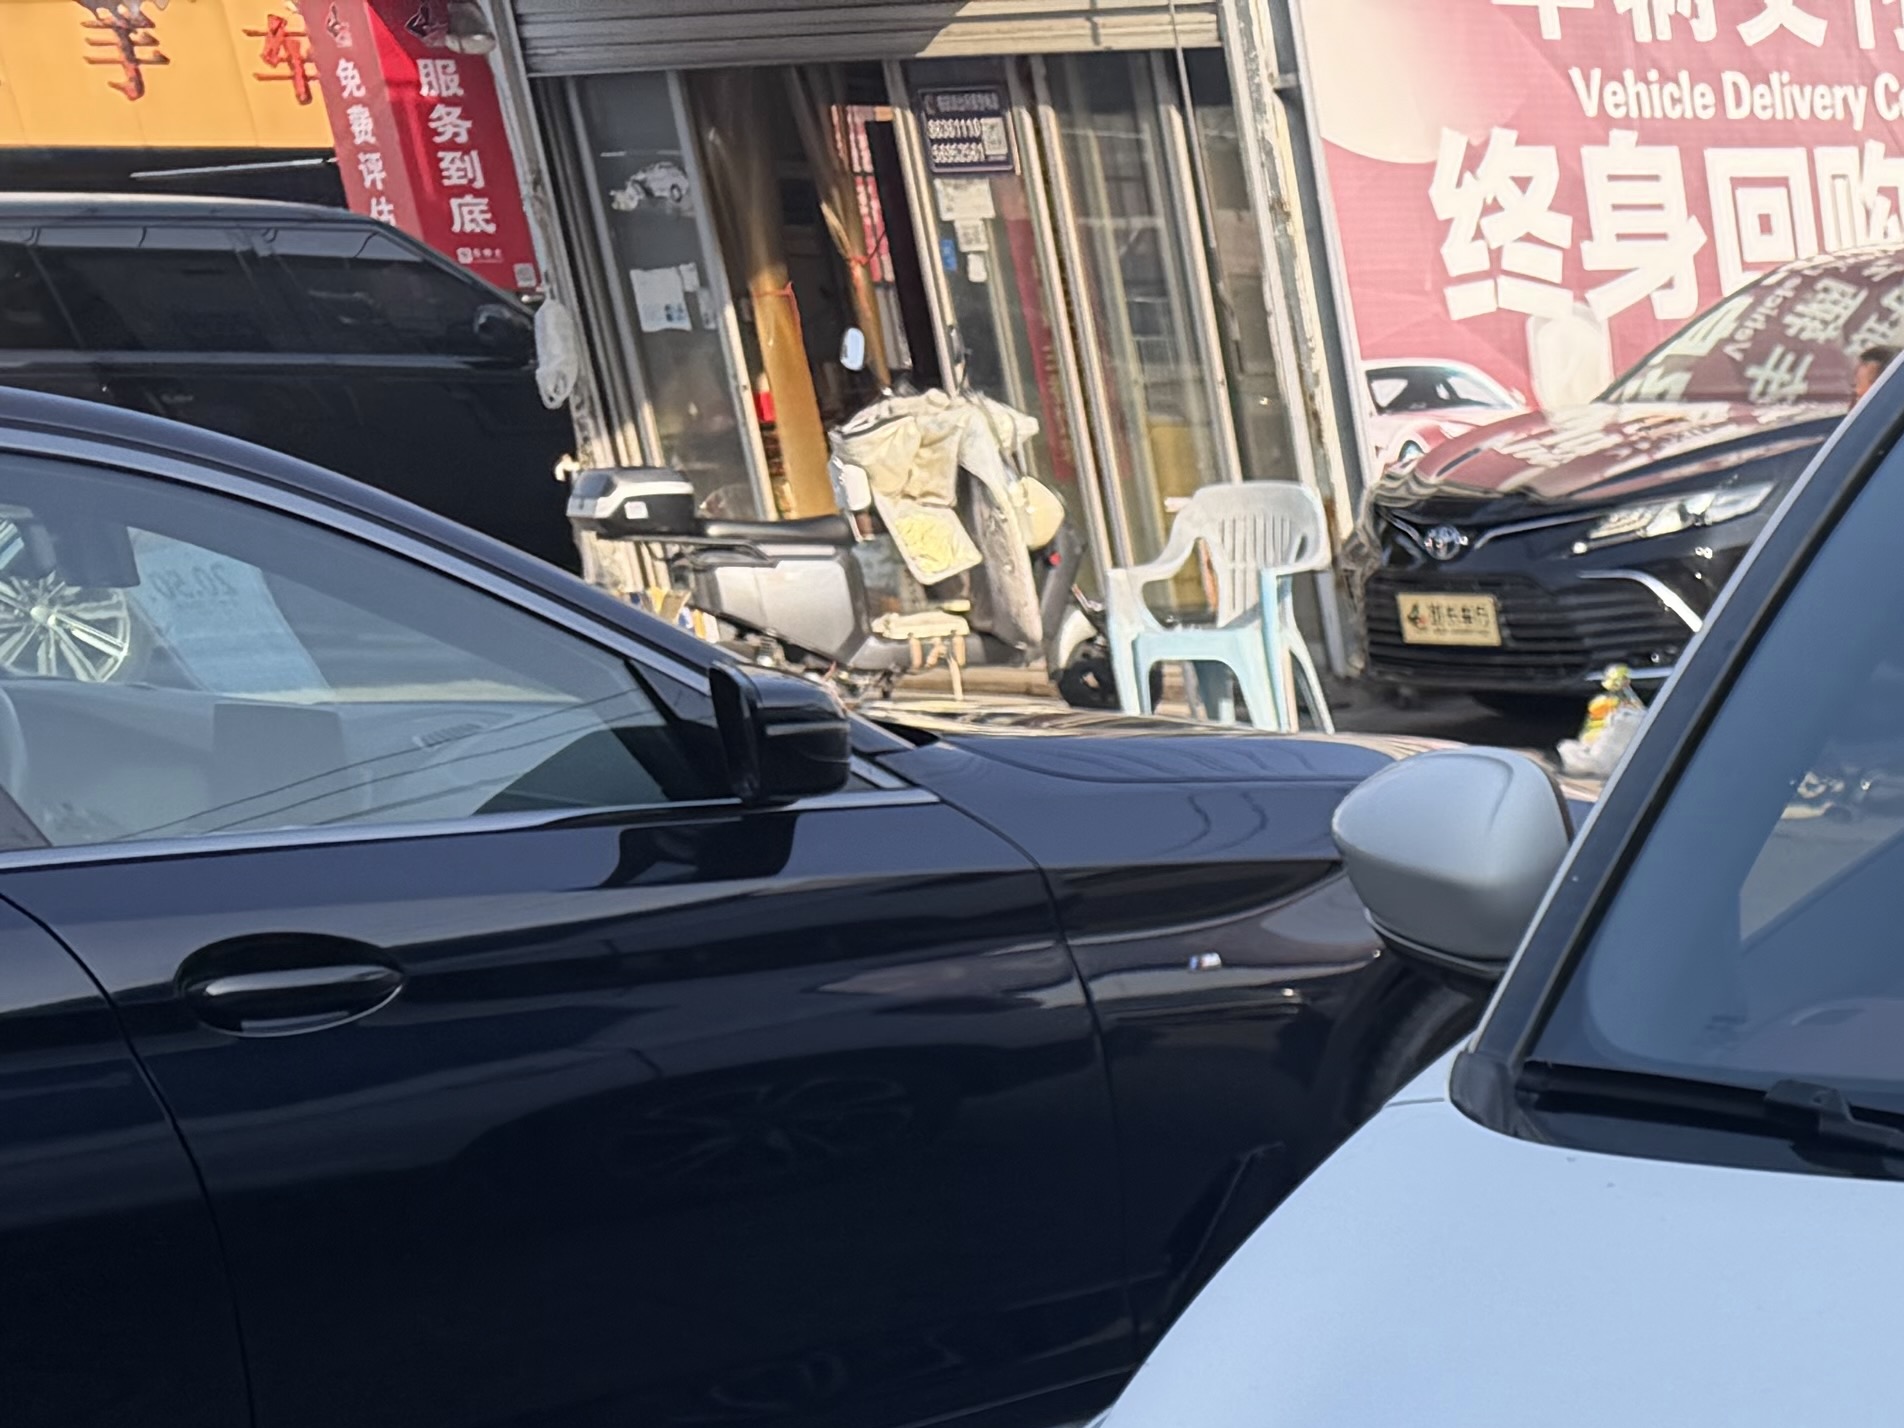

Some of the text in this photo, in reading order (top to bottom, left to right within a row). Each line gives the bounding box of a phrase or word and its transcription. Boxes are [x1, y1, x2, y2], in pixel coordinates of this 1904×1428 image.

[416, 58, 497, 235] 服务到底
[1568, 67, 1715, 118] Vehicle
[1720, 70, 1867, 131] Delivery
